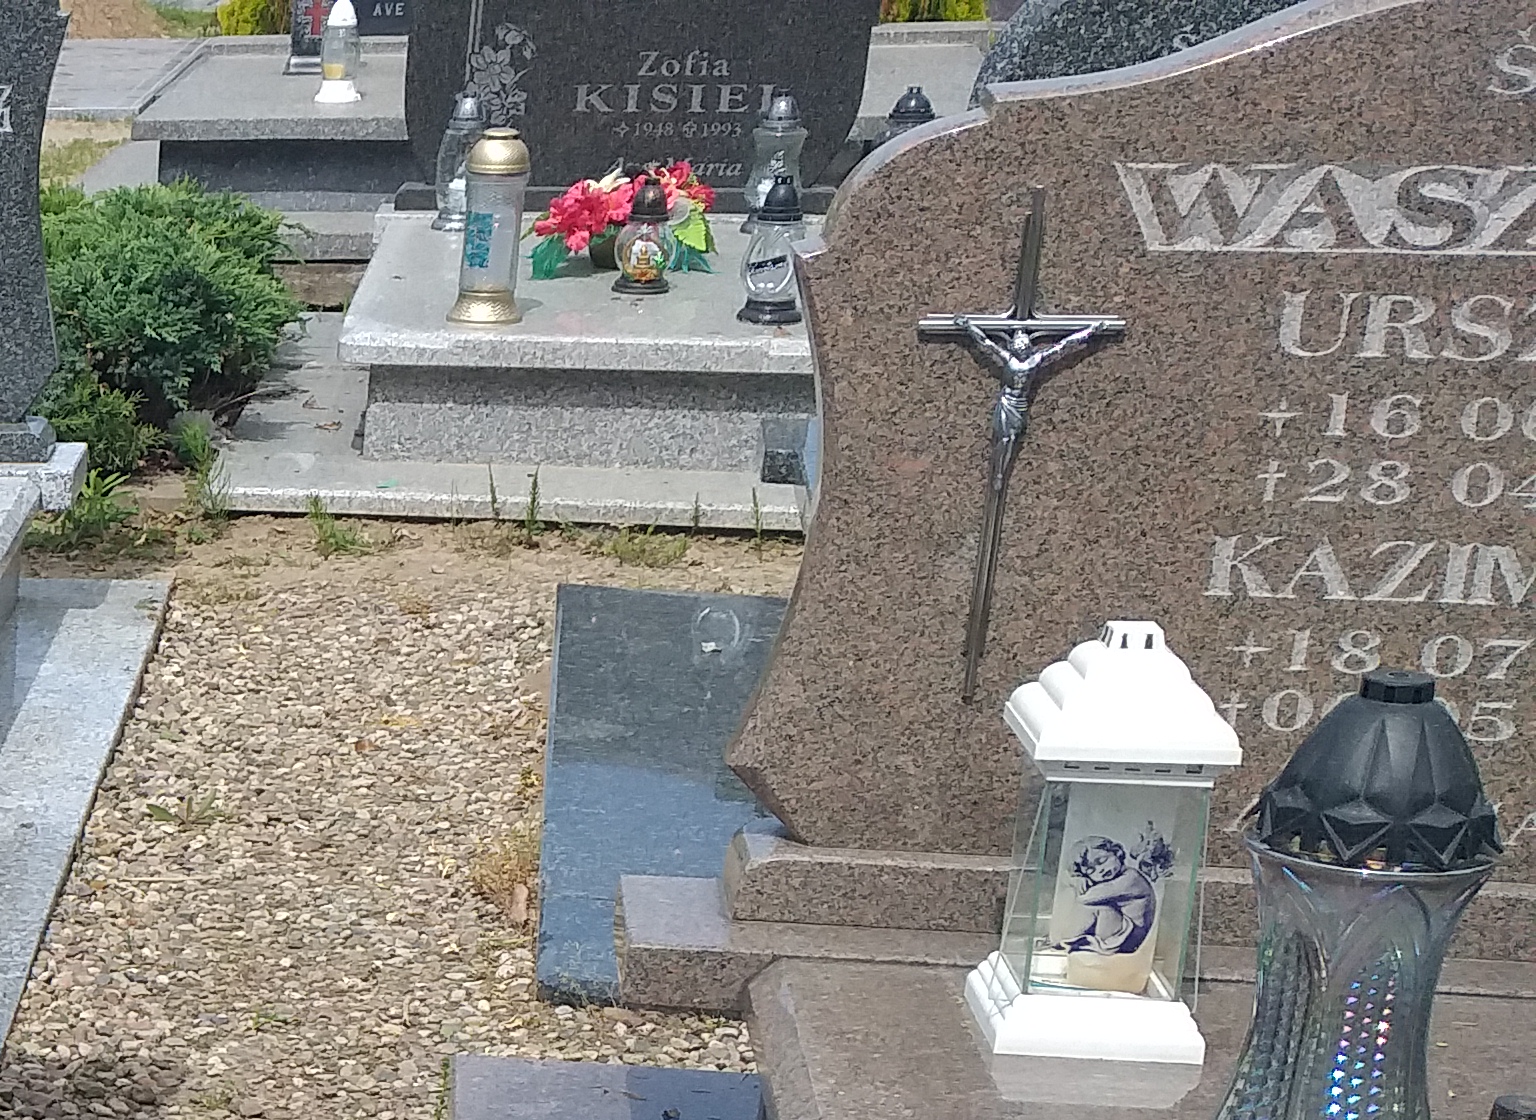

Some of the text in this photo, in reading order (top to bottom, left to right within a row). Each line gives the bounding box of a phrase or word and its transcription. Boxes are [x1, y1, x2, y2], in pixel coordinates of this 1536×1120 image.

[373, 2, 405, 17] AVE
[637, 50, 730, 77] Zofia
[633, 122, 743, 138] 1948 1993
[1278, 289, 1536, 362] URS
[1322, 391, 1536, 442] 16 0
[1301, 457, 1412, 505] 28
[1282, 626, 1382, 675] 18
